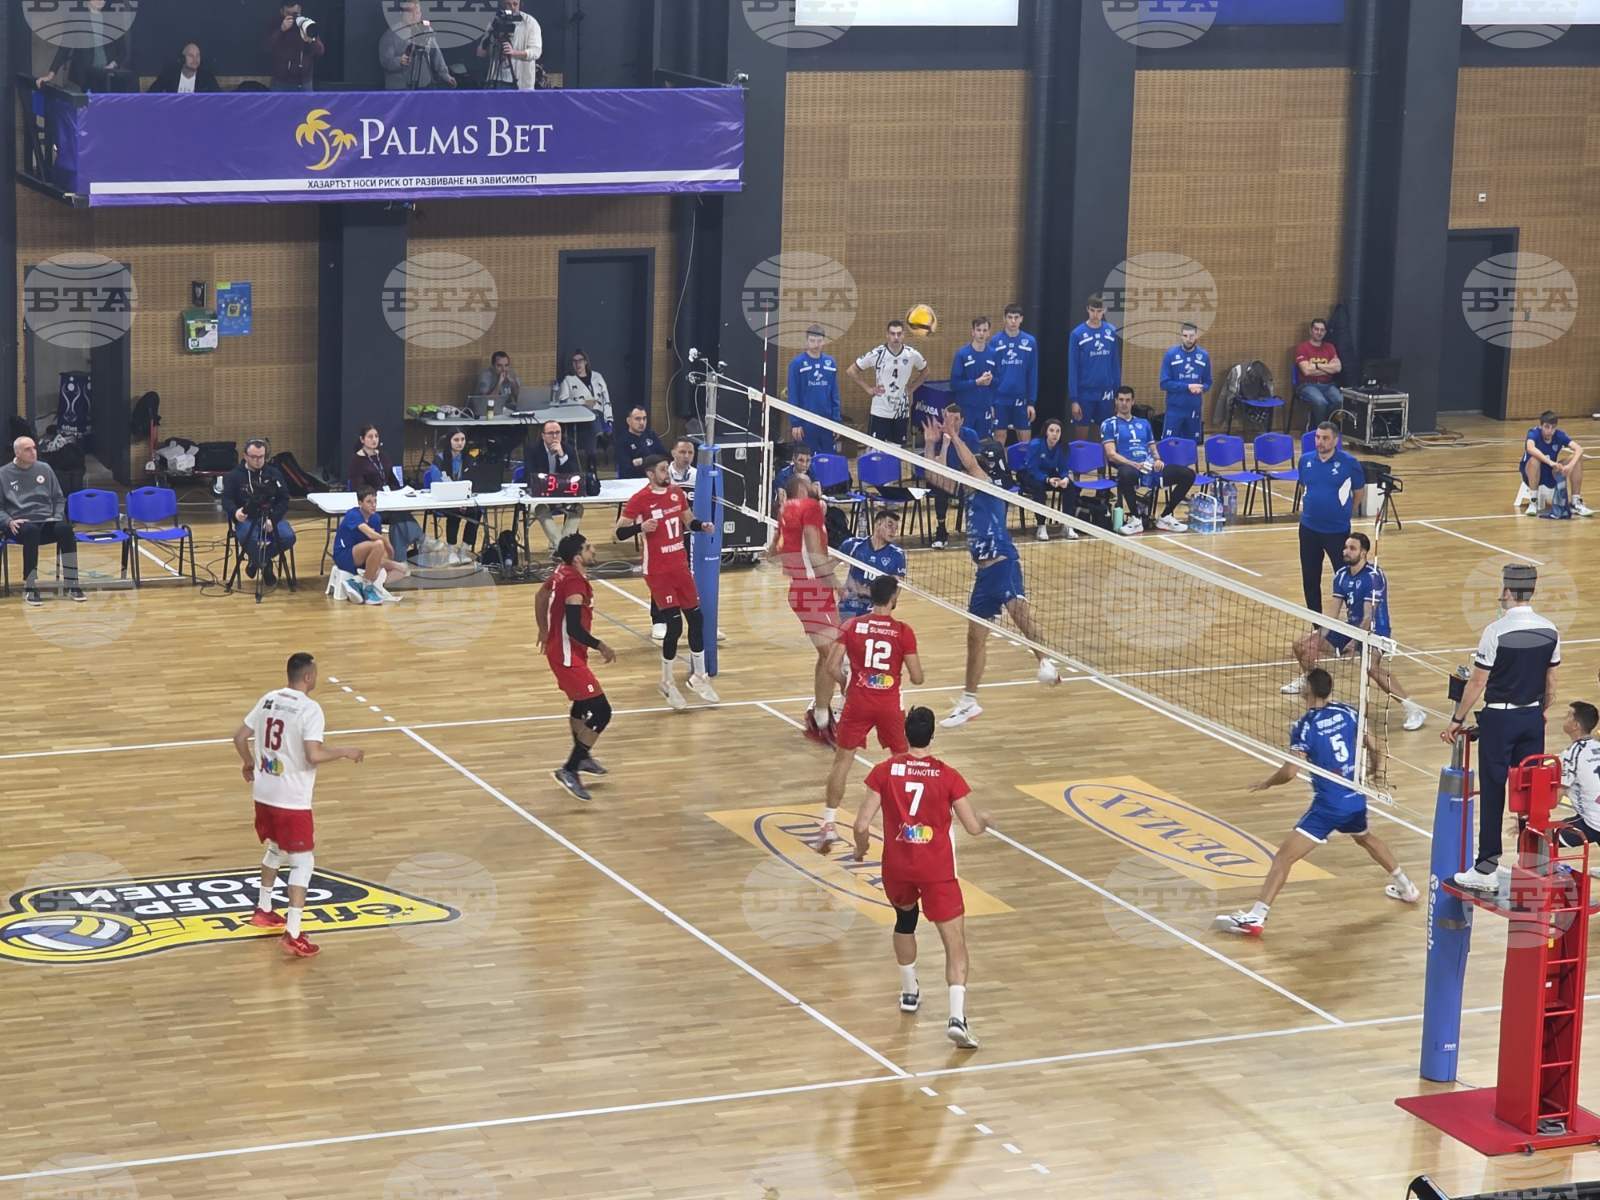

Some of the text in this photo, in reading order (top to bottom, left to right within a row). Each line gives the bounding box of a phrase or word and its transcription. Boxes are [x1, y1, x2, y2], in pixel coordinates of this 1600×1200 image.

[360, 116, 554, 159] PALMS BET
[307, 175, 537, 188] ХАЗАРТЪТ НОСИ РИСК ОТ РАЗВИВАНЕ НА ЗАВИСИМОСТ!
[892, 368, 898, 378] 4
[1130, 430, 1137, 440] 1
[547, 475, 556, 491] 3
[665, 516, 680, 539] 17
[661, 541, 685, 554] WINBE
[864, 638, 892, 671] 12
[264, 717, 284, 751] 13
[1329, 733, 1349, 762] 5
[904, 781, 925, 816] 7
[1084, 793, 1261, 867] DEMAX
[203, 902, 403, 932] efbt
[1427, 891, 1437, 950] Senoh
